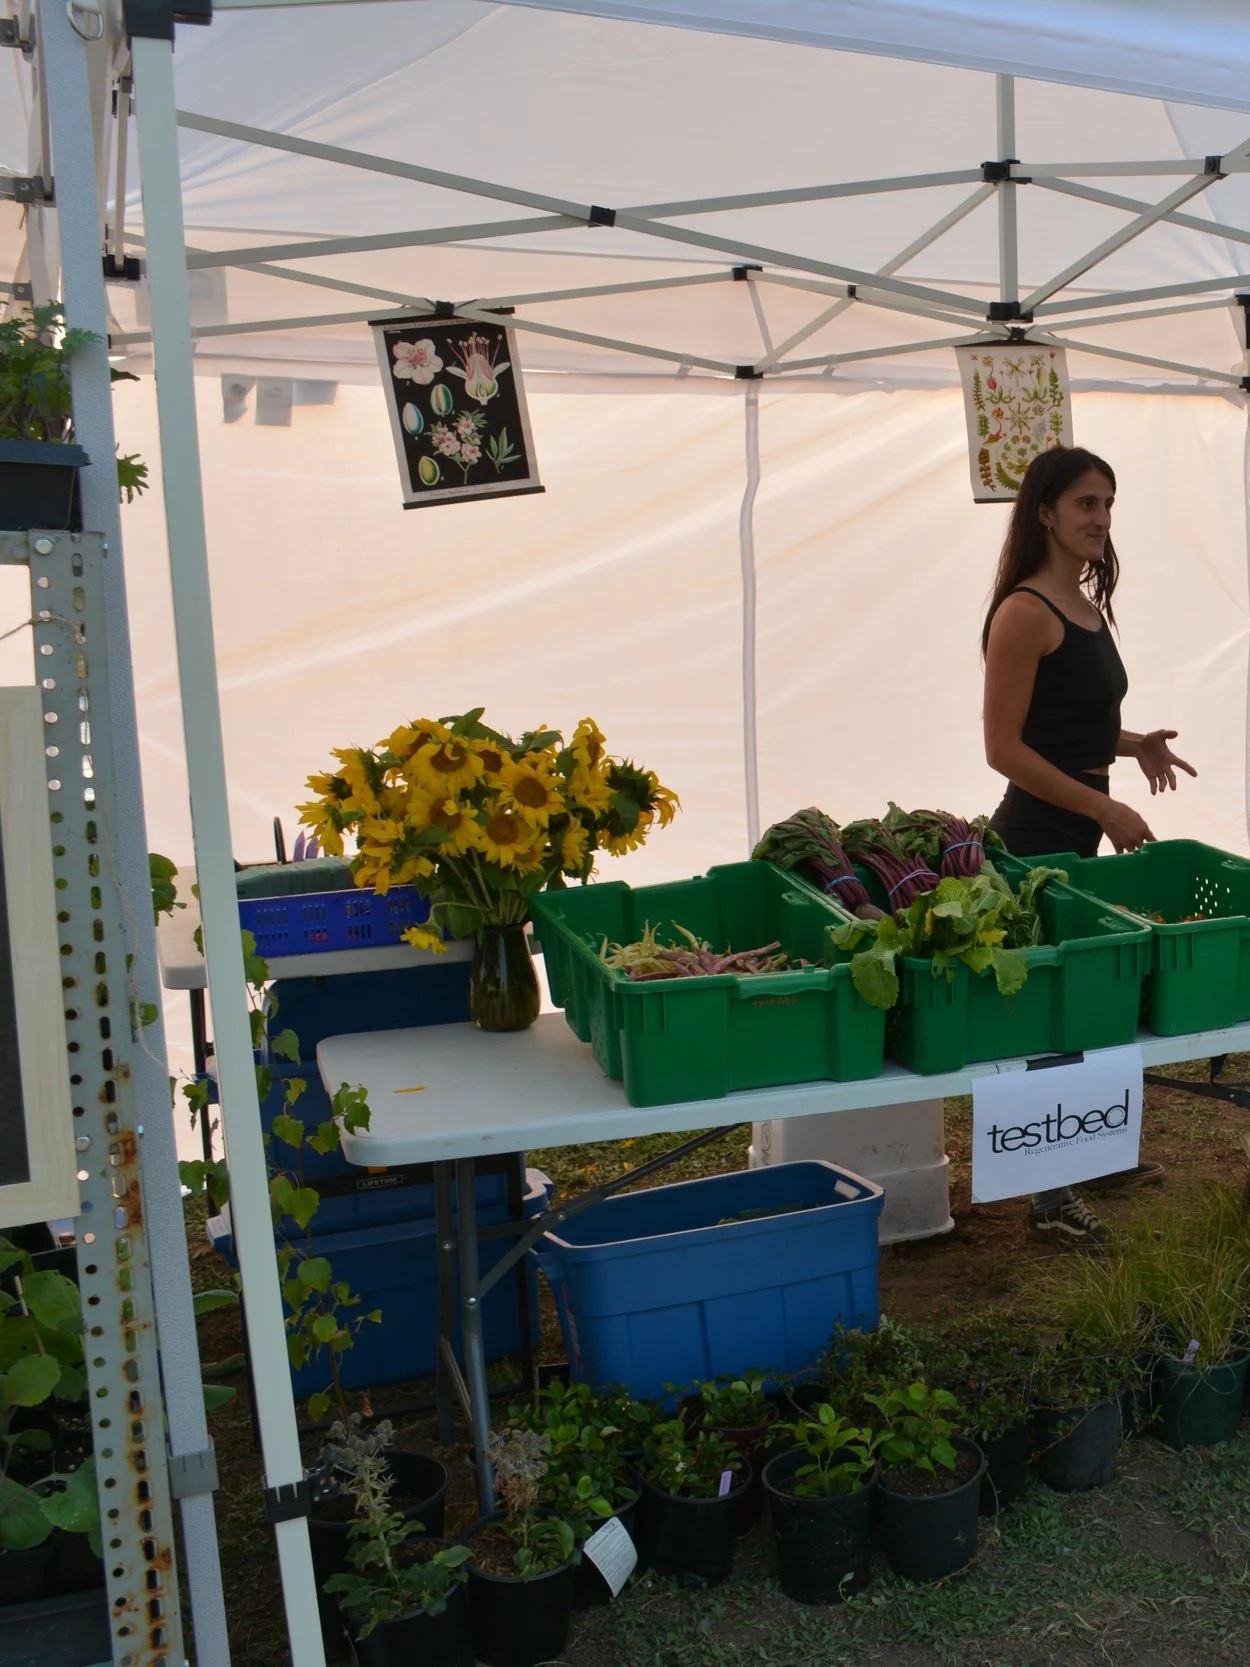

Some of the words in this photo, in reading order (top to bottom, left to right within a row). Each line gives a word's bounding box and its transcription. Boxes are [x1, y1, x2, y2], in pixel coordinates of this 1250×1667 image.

[986, 1088, 1129, 1154] testbed
[1024, 1139, 1075, 1157] Regenerative
[1075, 1133, 1096, 1145] Food
[1096, 1127, 1128, 1140] Systems
